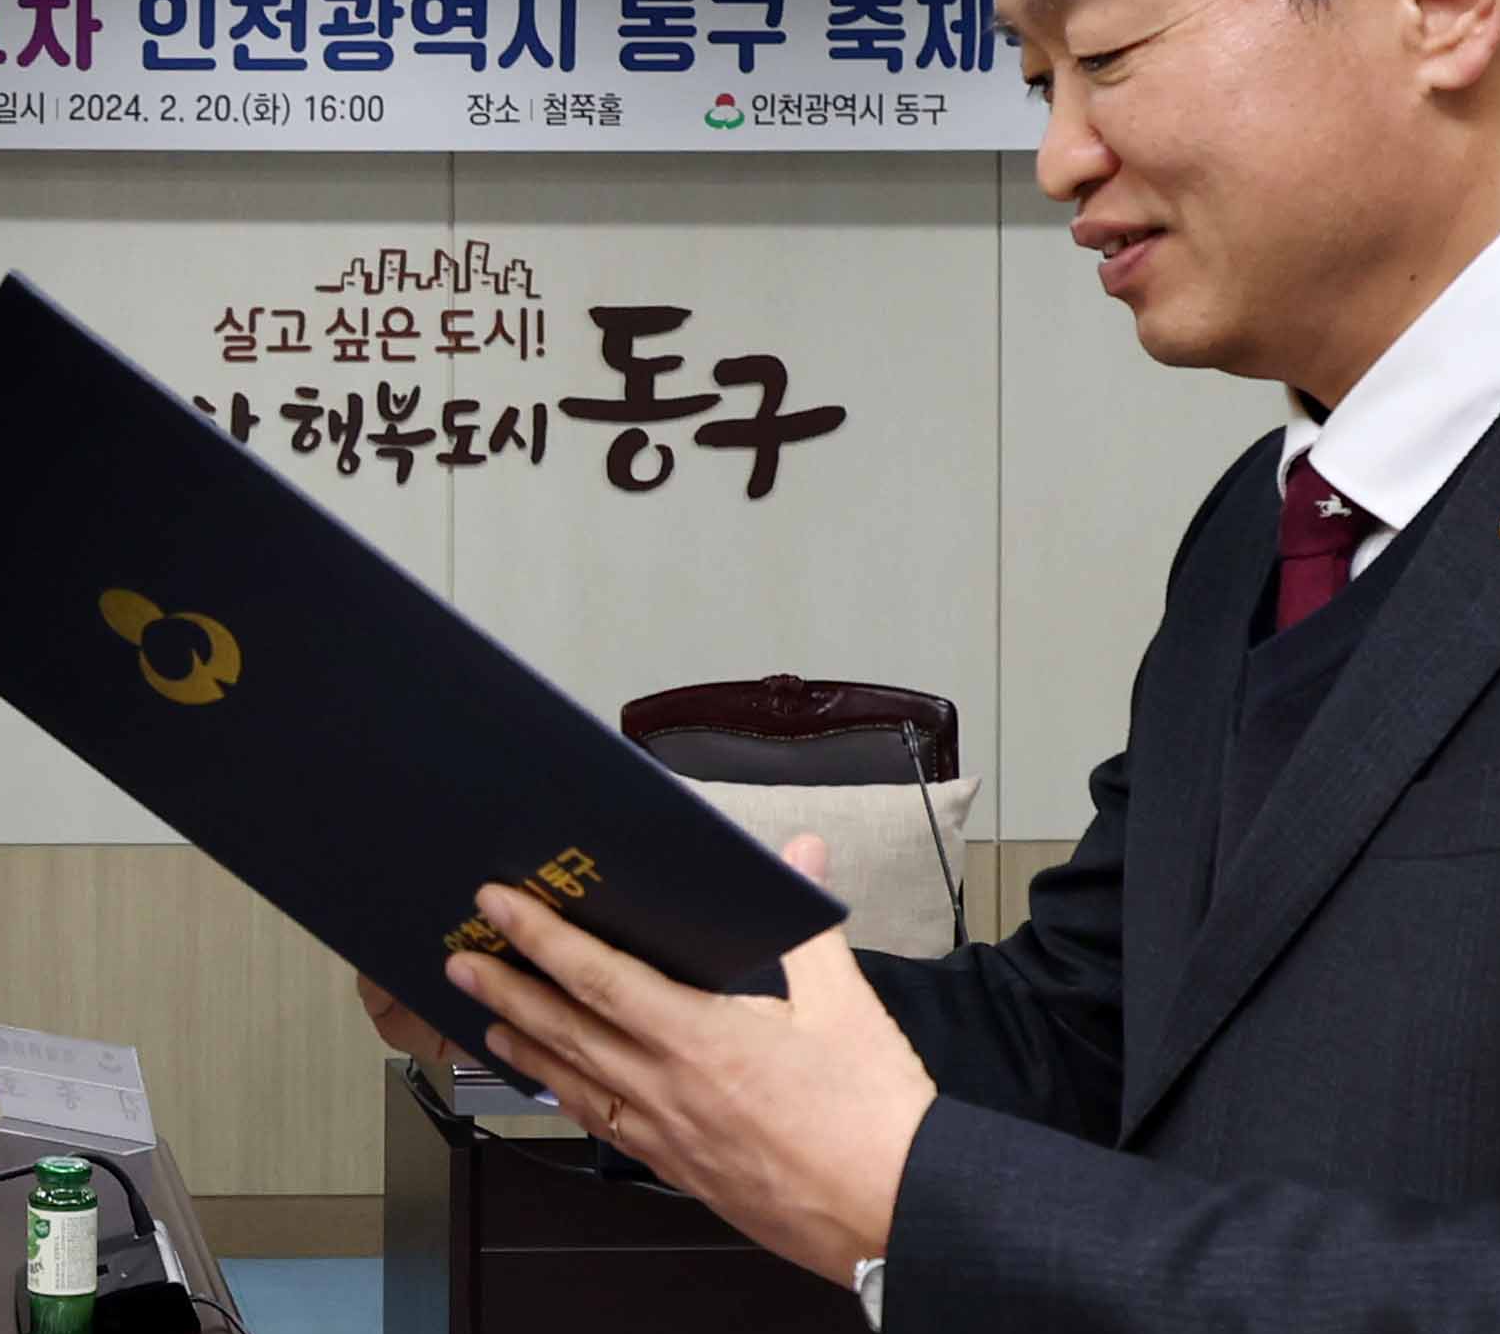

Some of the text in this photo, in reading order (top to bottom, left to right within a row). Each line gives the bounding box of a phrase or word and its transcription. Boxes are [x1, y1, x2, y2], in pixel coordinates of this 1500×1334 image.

[68, 93, 149, 124] 2024.
[160, 93, 185, 124] 2.
[195, 92, 291, 127] 20.(화)
[304, 93, 385, 124] 16:00
[466, 93, 625, 127] 장소 철쭉홀
[751, 92, 948, 127] 인천광역시 동구
[214, 305, 547, 364] 살고 싶은 도시!
[280, 304, 848, 500] 행복도시 동구
